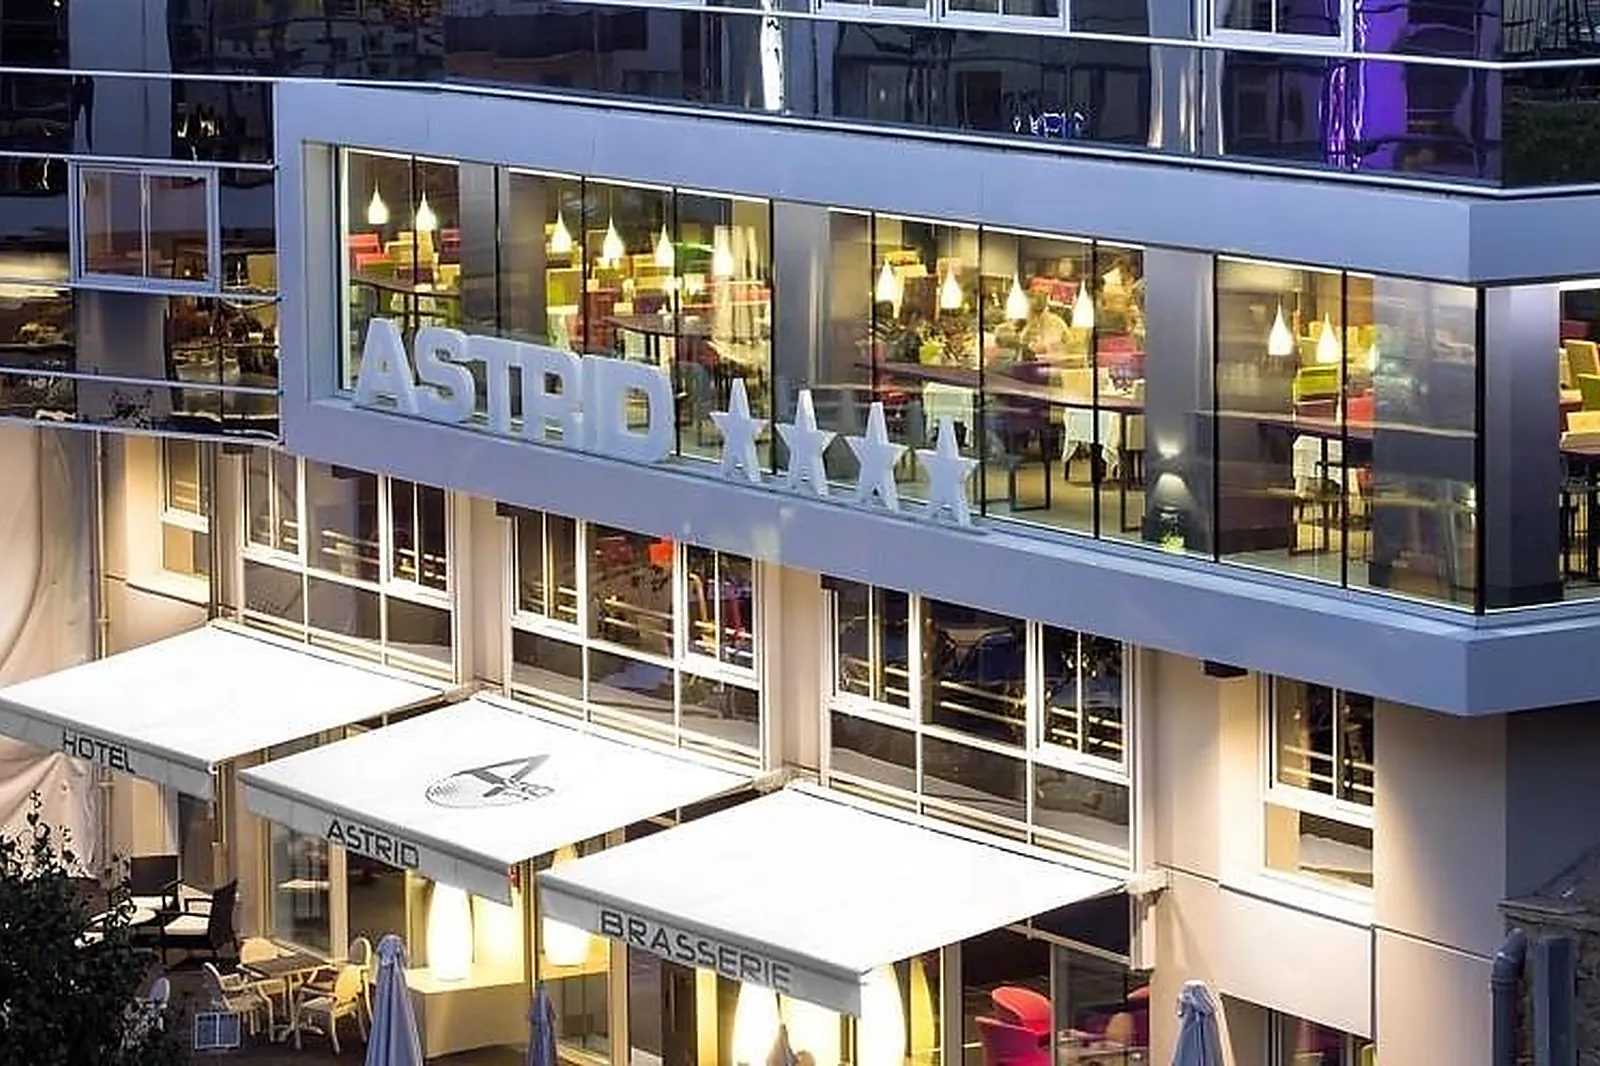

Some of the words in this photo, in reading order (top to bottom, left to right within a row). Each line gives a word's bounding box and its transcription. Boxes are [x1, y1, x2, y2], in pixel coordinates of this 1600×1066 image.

[351, 317, 676, 463] ASTRID
[63, 727, 136, 774] HOTEL
[326, 819, 420, 869] ASTRID
[600, 909, 792, 993] BRASSERIE
